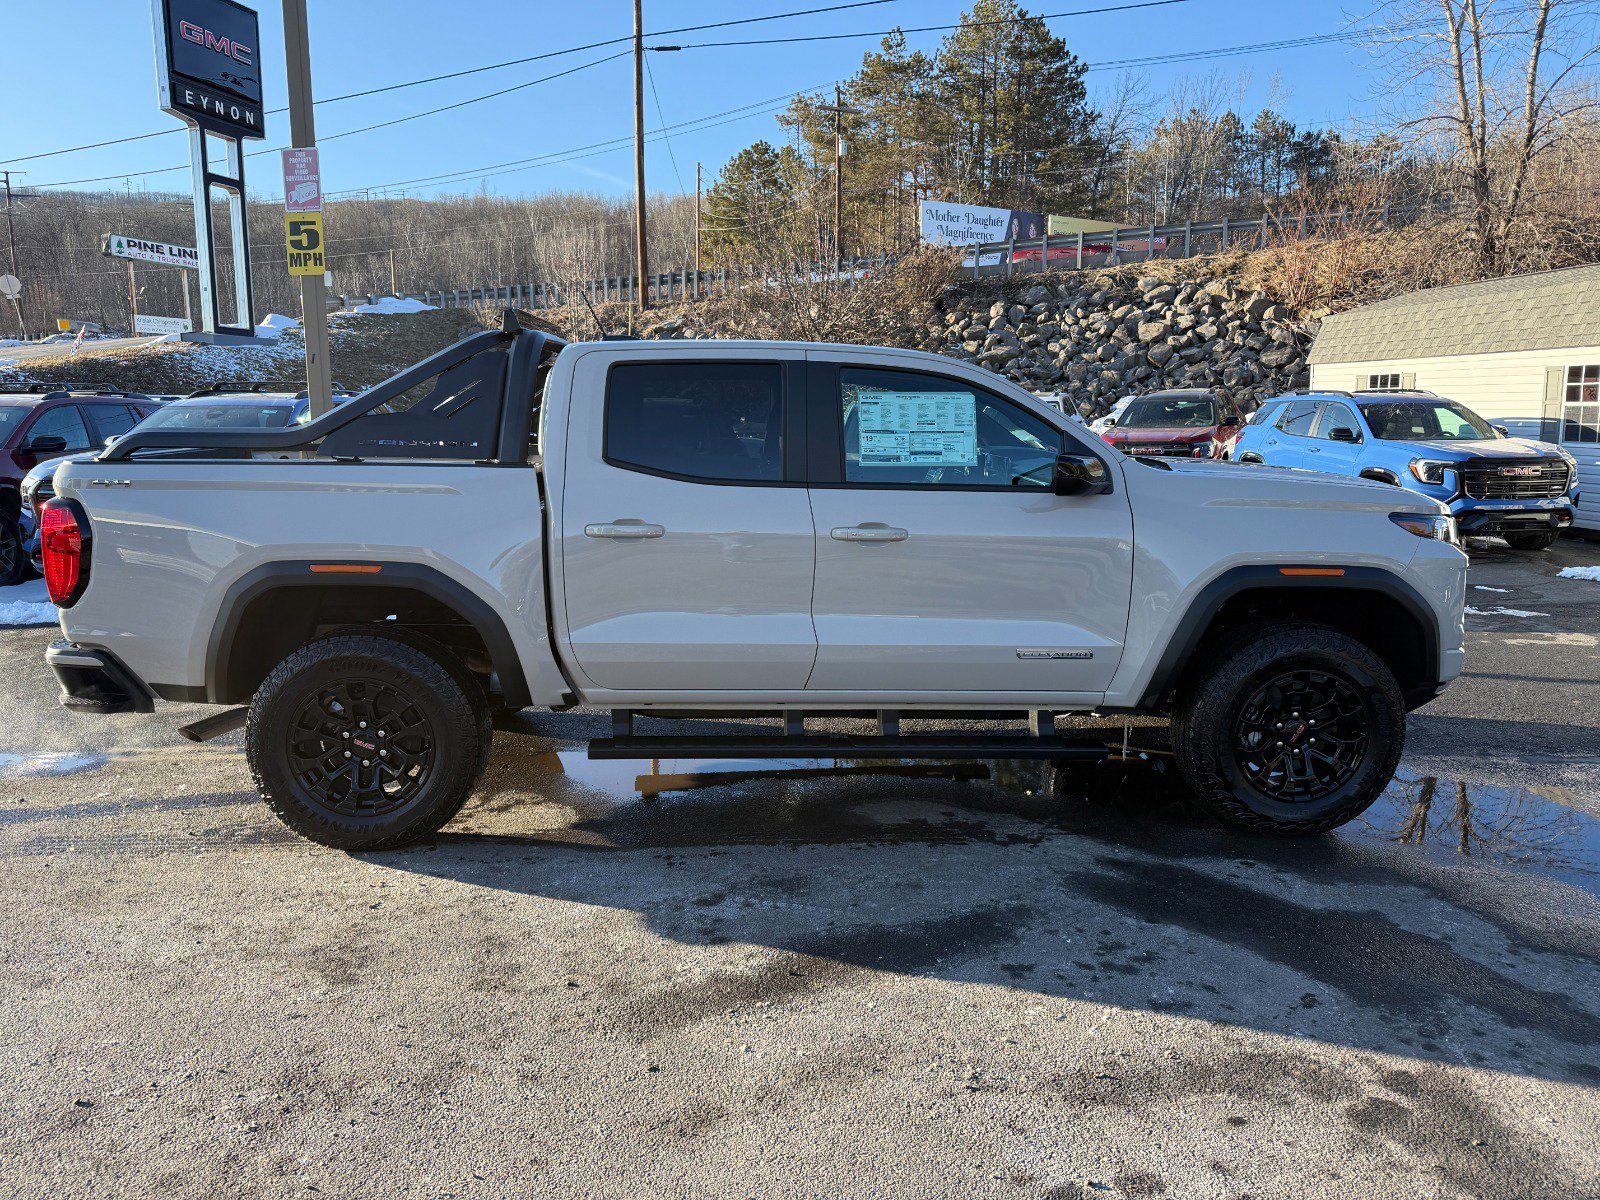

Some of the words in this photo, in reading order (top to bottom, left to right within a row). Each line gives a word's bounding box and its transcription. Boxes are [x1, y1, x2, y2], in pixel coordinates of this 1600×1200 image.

[180, 20, 251, 65] GMC
[185, 89, 254, 125] EYNON
[289, 221, 319, 250] 5
[937, 225, 995, 242] Magnificence
[127, 239, 165, 255] PINE
[128, 251, 147, 259] AUTO
[158, 256, 180, 264] TRUCK
[289, 253, 323, 267] MPH
[1503, 466, 1541, 476] GMC
[353, 738, 376, 751] GMC
